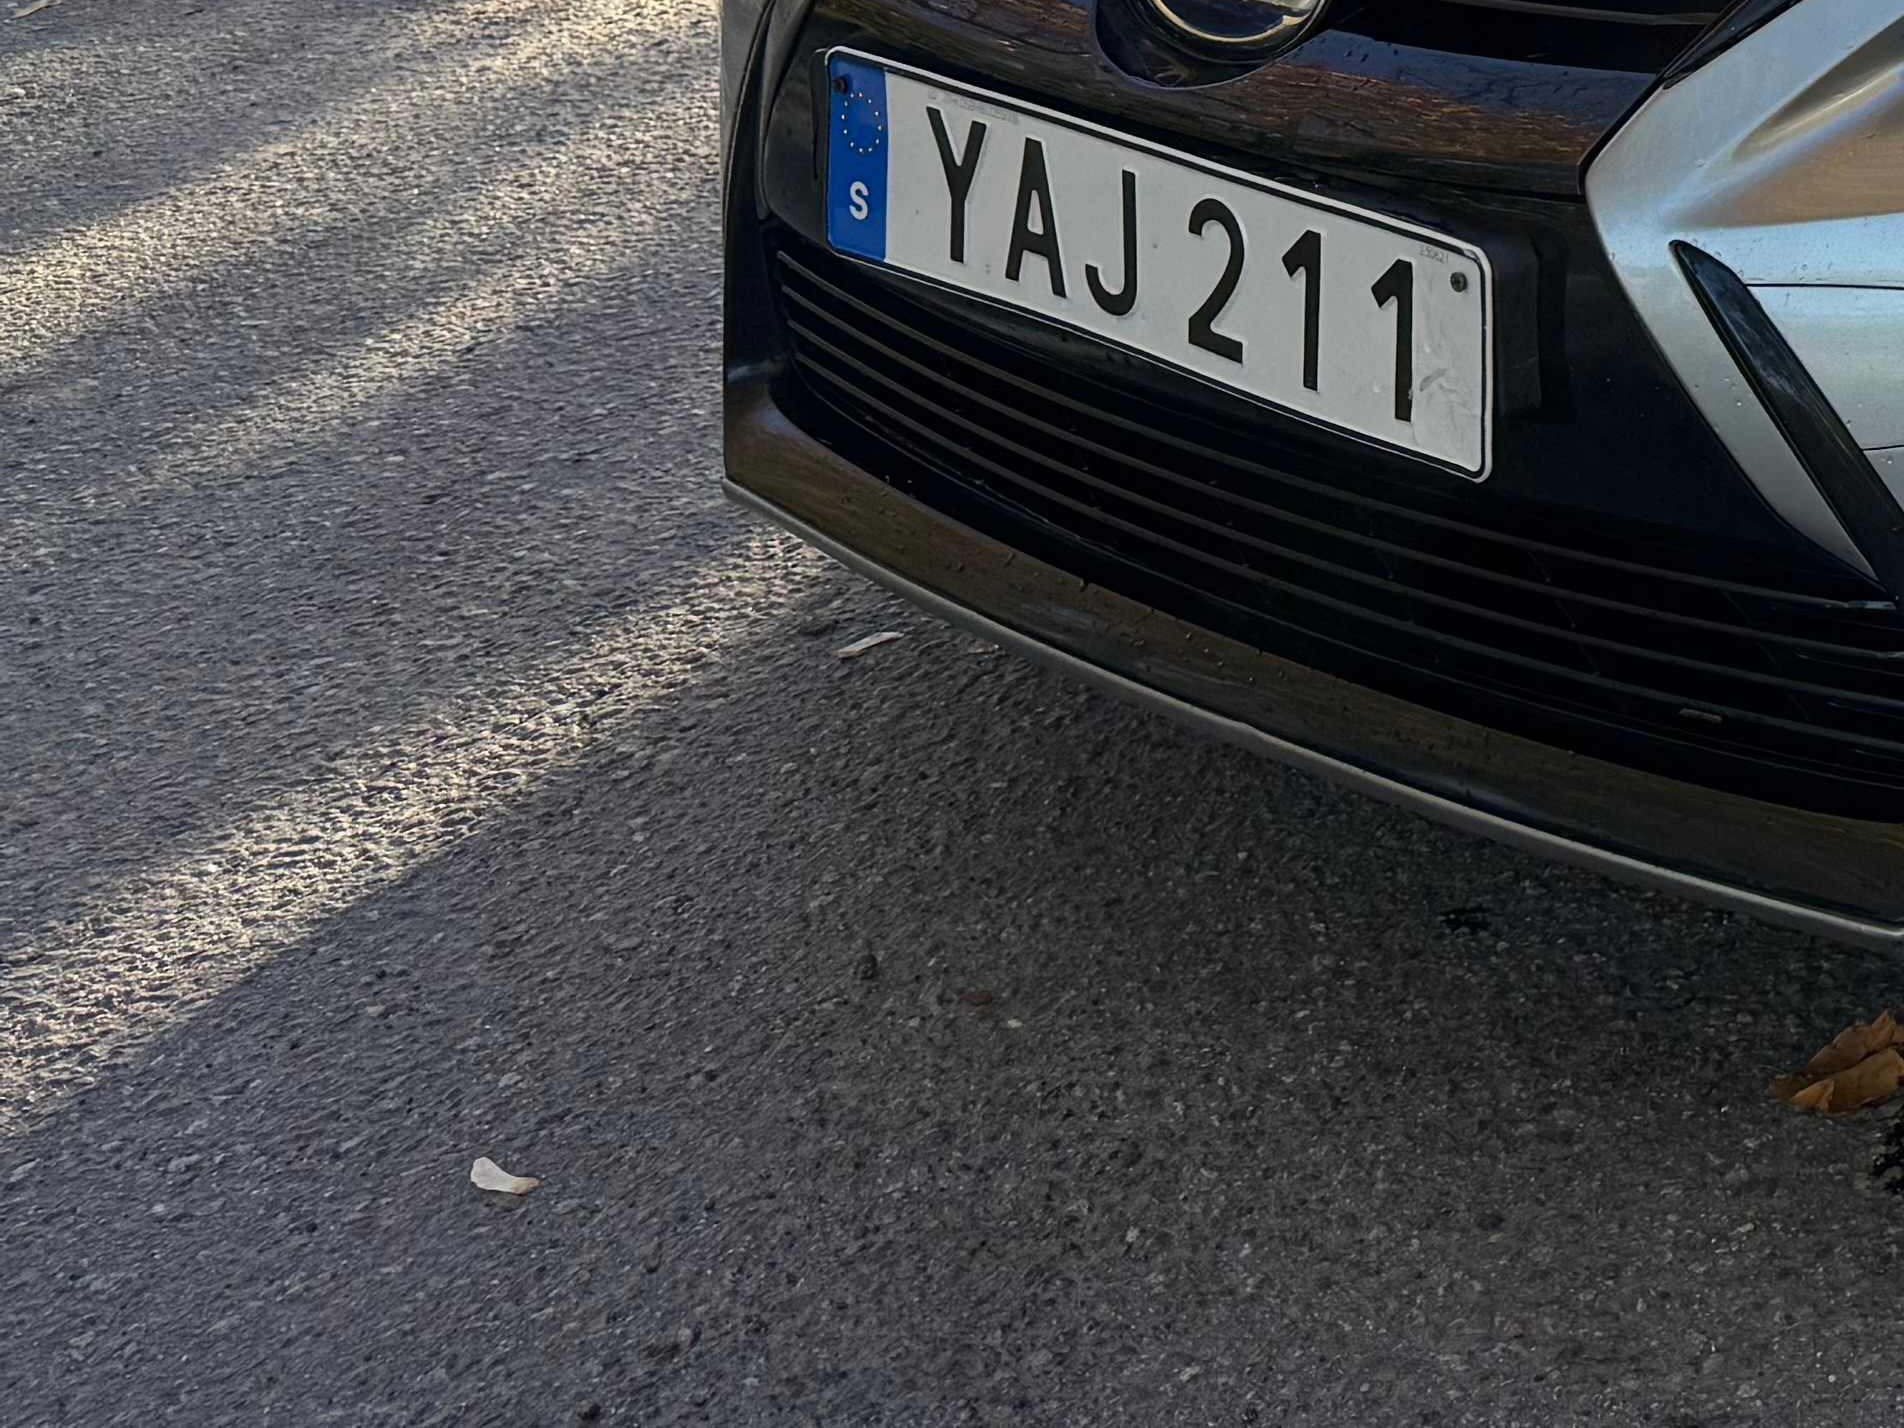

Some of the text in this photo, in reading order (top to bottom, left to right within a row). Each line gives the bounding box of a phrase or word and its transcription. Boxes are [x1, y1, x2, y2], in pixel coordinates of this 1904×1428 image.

[848, 105, 1414, 423] S YAJ 211
